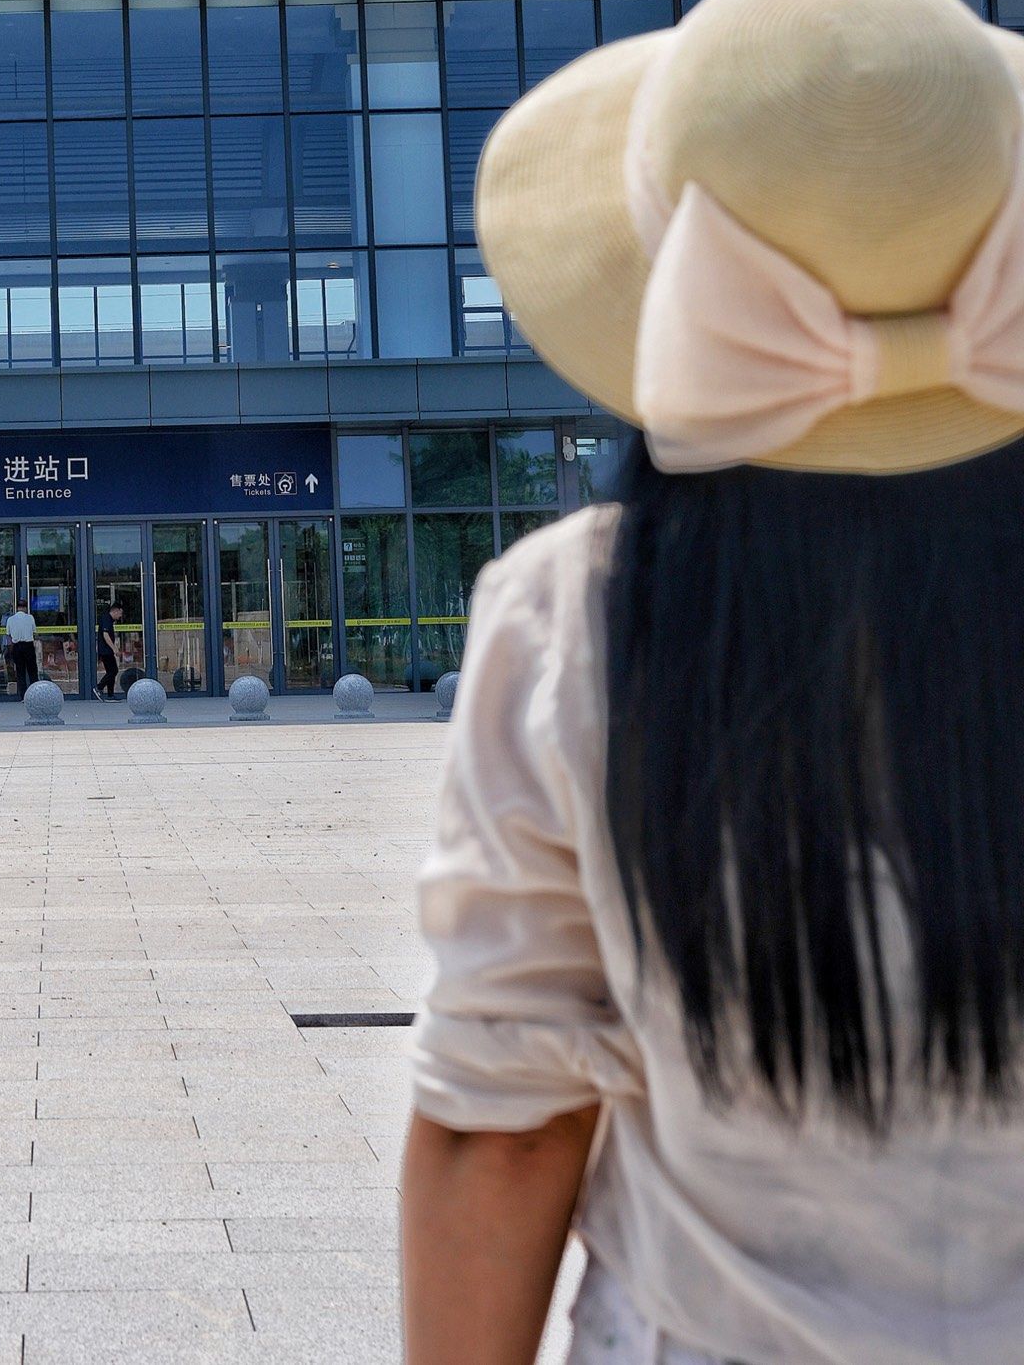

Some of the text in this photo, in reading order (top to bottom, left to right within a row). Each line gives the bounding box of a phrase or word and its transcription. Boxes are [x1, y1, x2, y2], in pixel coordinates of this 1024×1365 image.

[3, 455, 88, 483] 进站口
[229, 473, 271, 488] 售票处
[5, 487, 72, 500] Entrance
[243, 488, 272, 496] Tickets
